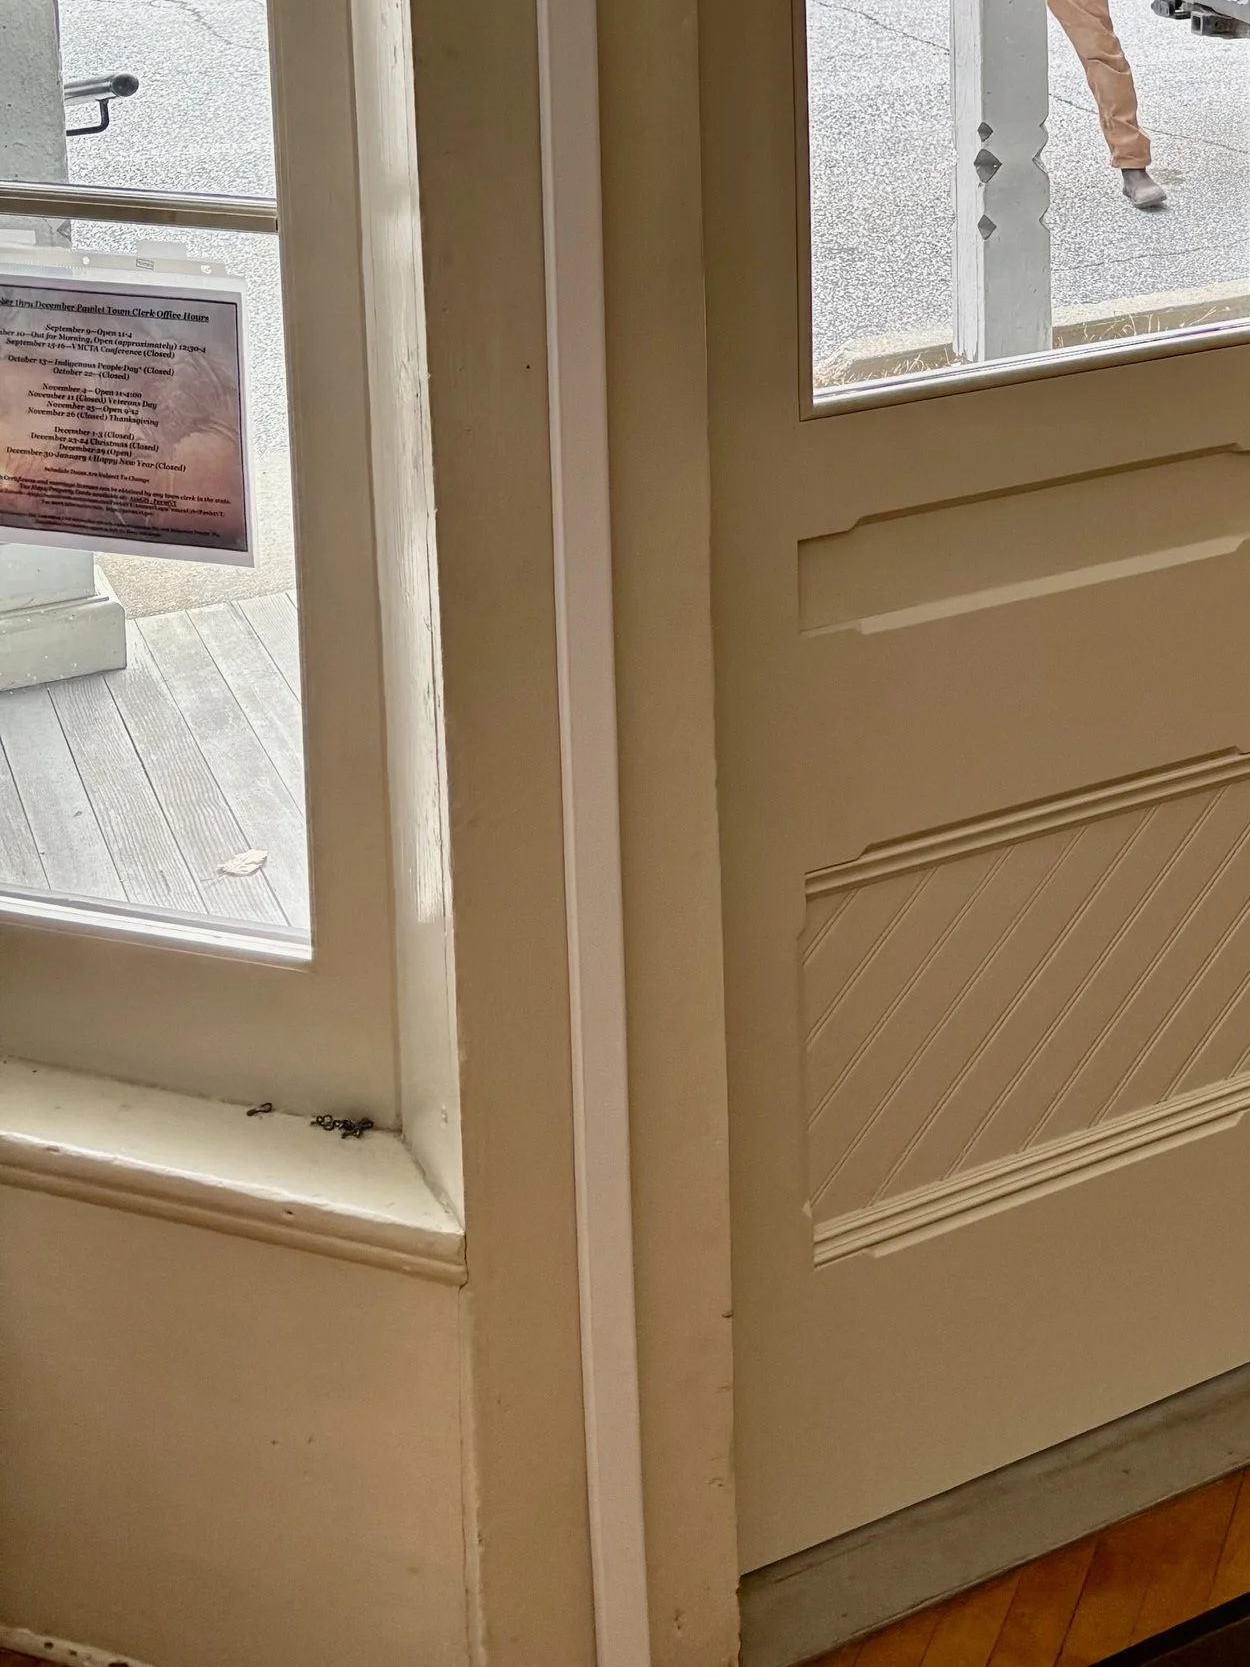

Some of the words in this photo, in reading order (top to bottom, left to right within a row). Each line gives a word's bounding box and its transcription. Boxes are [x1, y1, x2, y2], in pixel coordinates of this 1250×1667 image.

[35, 300, 75, 311] December
[107, 306, 130, 316] Town
[132, 308, 156, 318] Clerk
[157, 310, 181, 320] Office
[183, 312, 209, 323] Hours
[45, 324, 84, 335] September
[6, 338, 45, 348] September
[100, 346, 142, 356] Conference
[143, 349, 175, 359] (Closed)
[45, 332, 57, 340] for
[94, 337, 113, 346] Open
[114, 339, 177, 351] (approximately)
[8, 354, 37, 364] October
[97, 362, 123, 372] People
[143, 366, 175, 376] (Closed)
[53, 367, 82, 377] October
[43, 383, 80, 393] November
[95, 387, 114, 397] Open
[28, 390, 65, 400] November
[76, 394, 106, 404] (Closed)
[108, 397, 141, 407] Veterans
[142, 400, 158, 410] Day
[47, 400, 85, 410] November
[103, 406, 122, 414] Open
[28, 407, 65, 417] November
[76, 412, 108, 421] (Closed)
[109, 415, 159, 427] Thanksgiving
[31, 432, 67, 442] December
[90, 438, 128, 448] Christmas
[129, 442, 159, 452] (Closed)
[55, 426, 91, 436] December
[104, 431, 135, 441] (Closed)
[59, 443, 95, 453] December
[6, 446, 42, 456] December
[119, 457, 136, 466] New
[137, 459, 154, 468] Year
[155, 462, 186, 472] (Closed)
